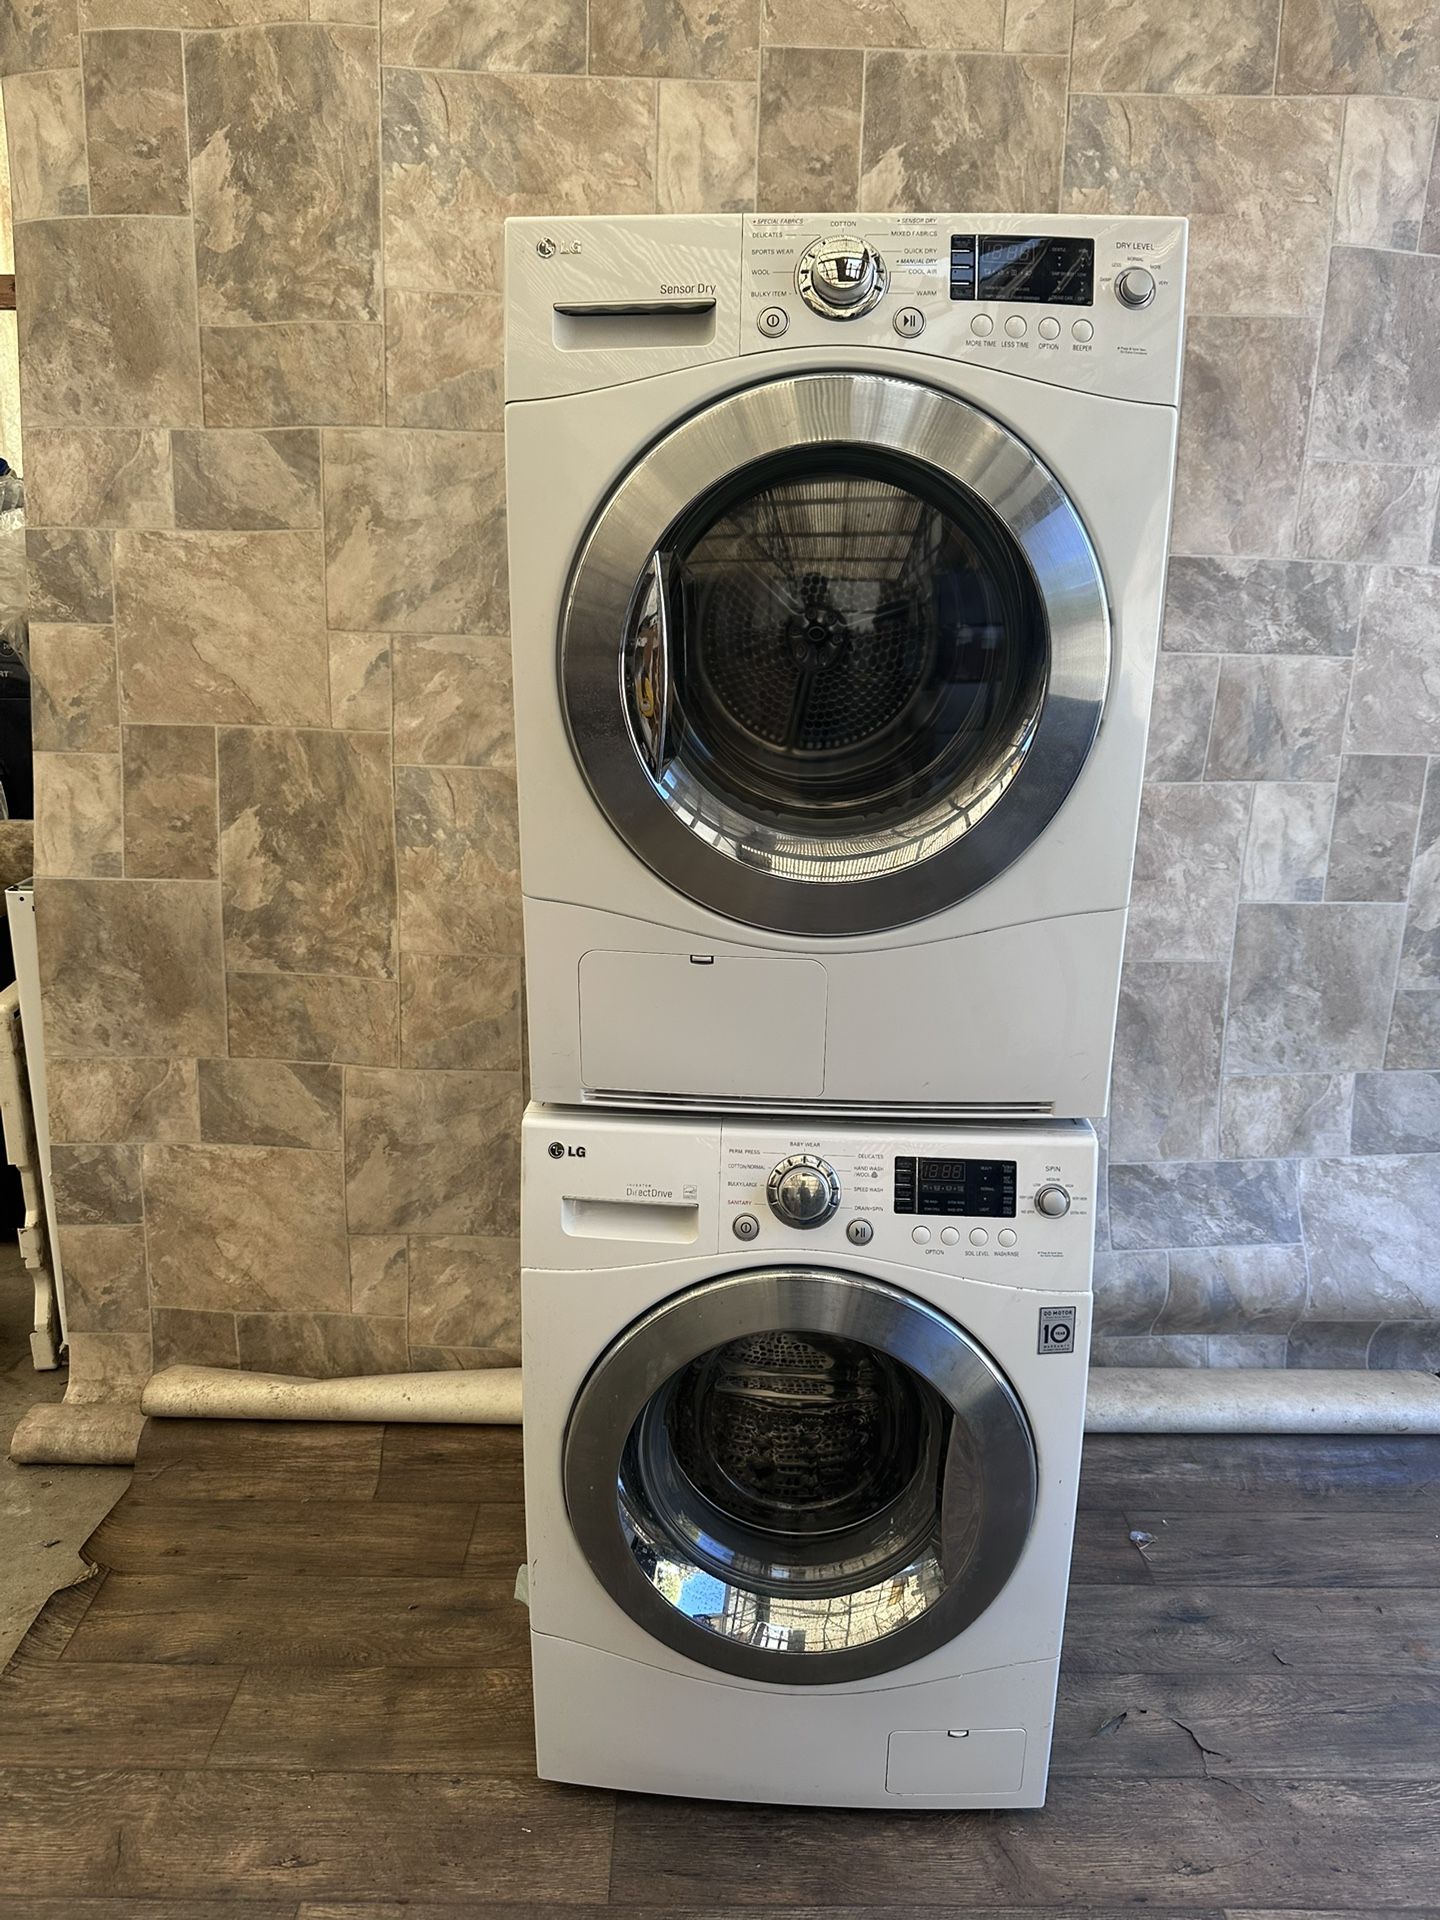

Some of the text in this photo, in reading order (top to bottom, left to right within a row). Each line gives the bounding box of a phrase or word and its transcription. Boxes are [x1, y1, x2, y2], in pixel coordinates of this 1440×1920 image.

[560, 240, 582, 254] LG
[660, 283, 716, 295] Sensor Dry
[568, 1146, 586, 1158] LG
[1043, 1323, 1071, 1344] 10
